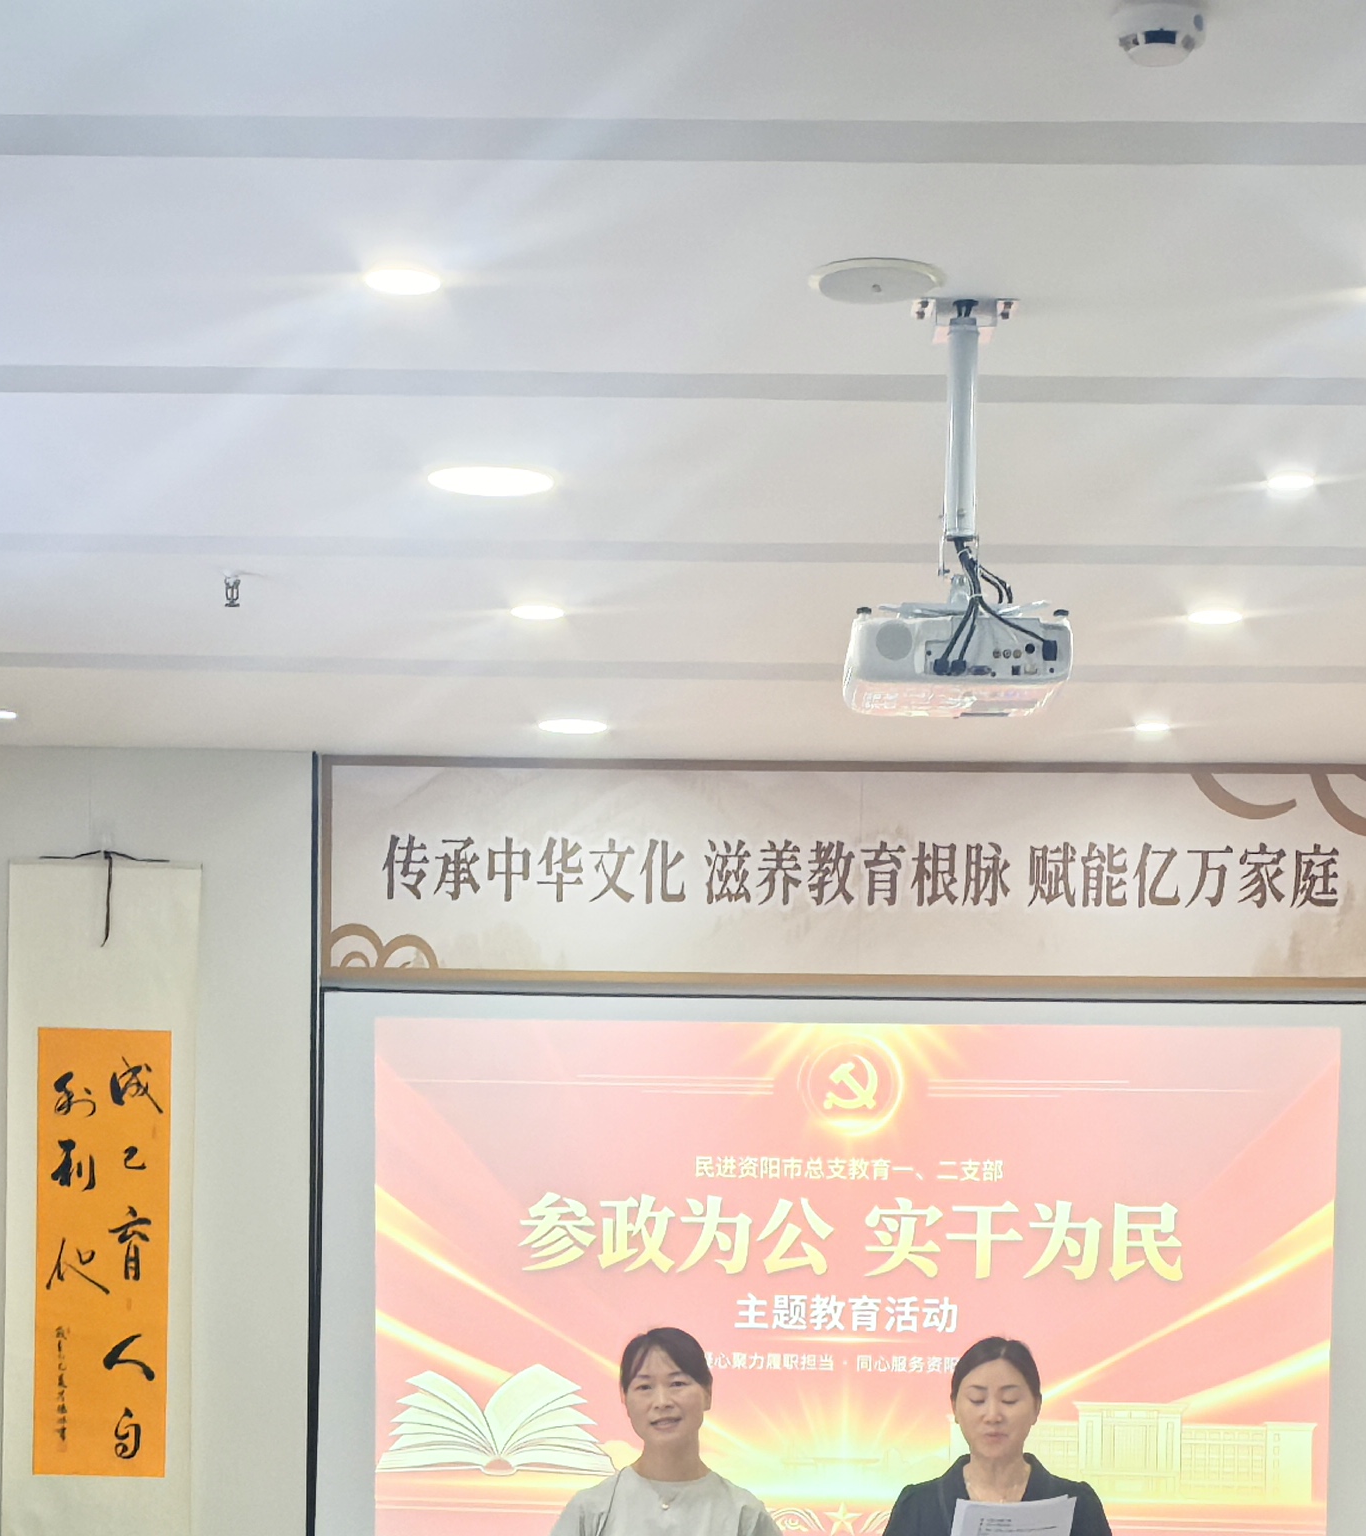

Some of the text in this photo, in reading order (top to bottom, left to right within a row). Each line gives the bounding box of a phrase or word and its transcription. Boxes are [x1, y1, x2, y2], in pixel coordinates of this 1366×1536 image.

[382, 833, 1340, 910] 传承中华文化 滋养教育根脉 赋能亿万家庭
[694, 1156, 1004, 1182] 民进资阳市总支教育一、二支部
[518, 1192, 1184, 1282] 参政为公 实干为民
[734, 1292, 958, 1333] 主题教育活动
